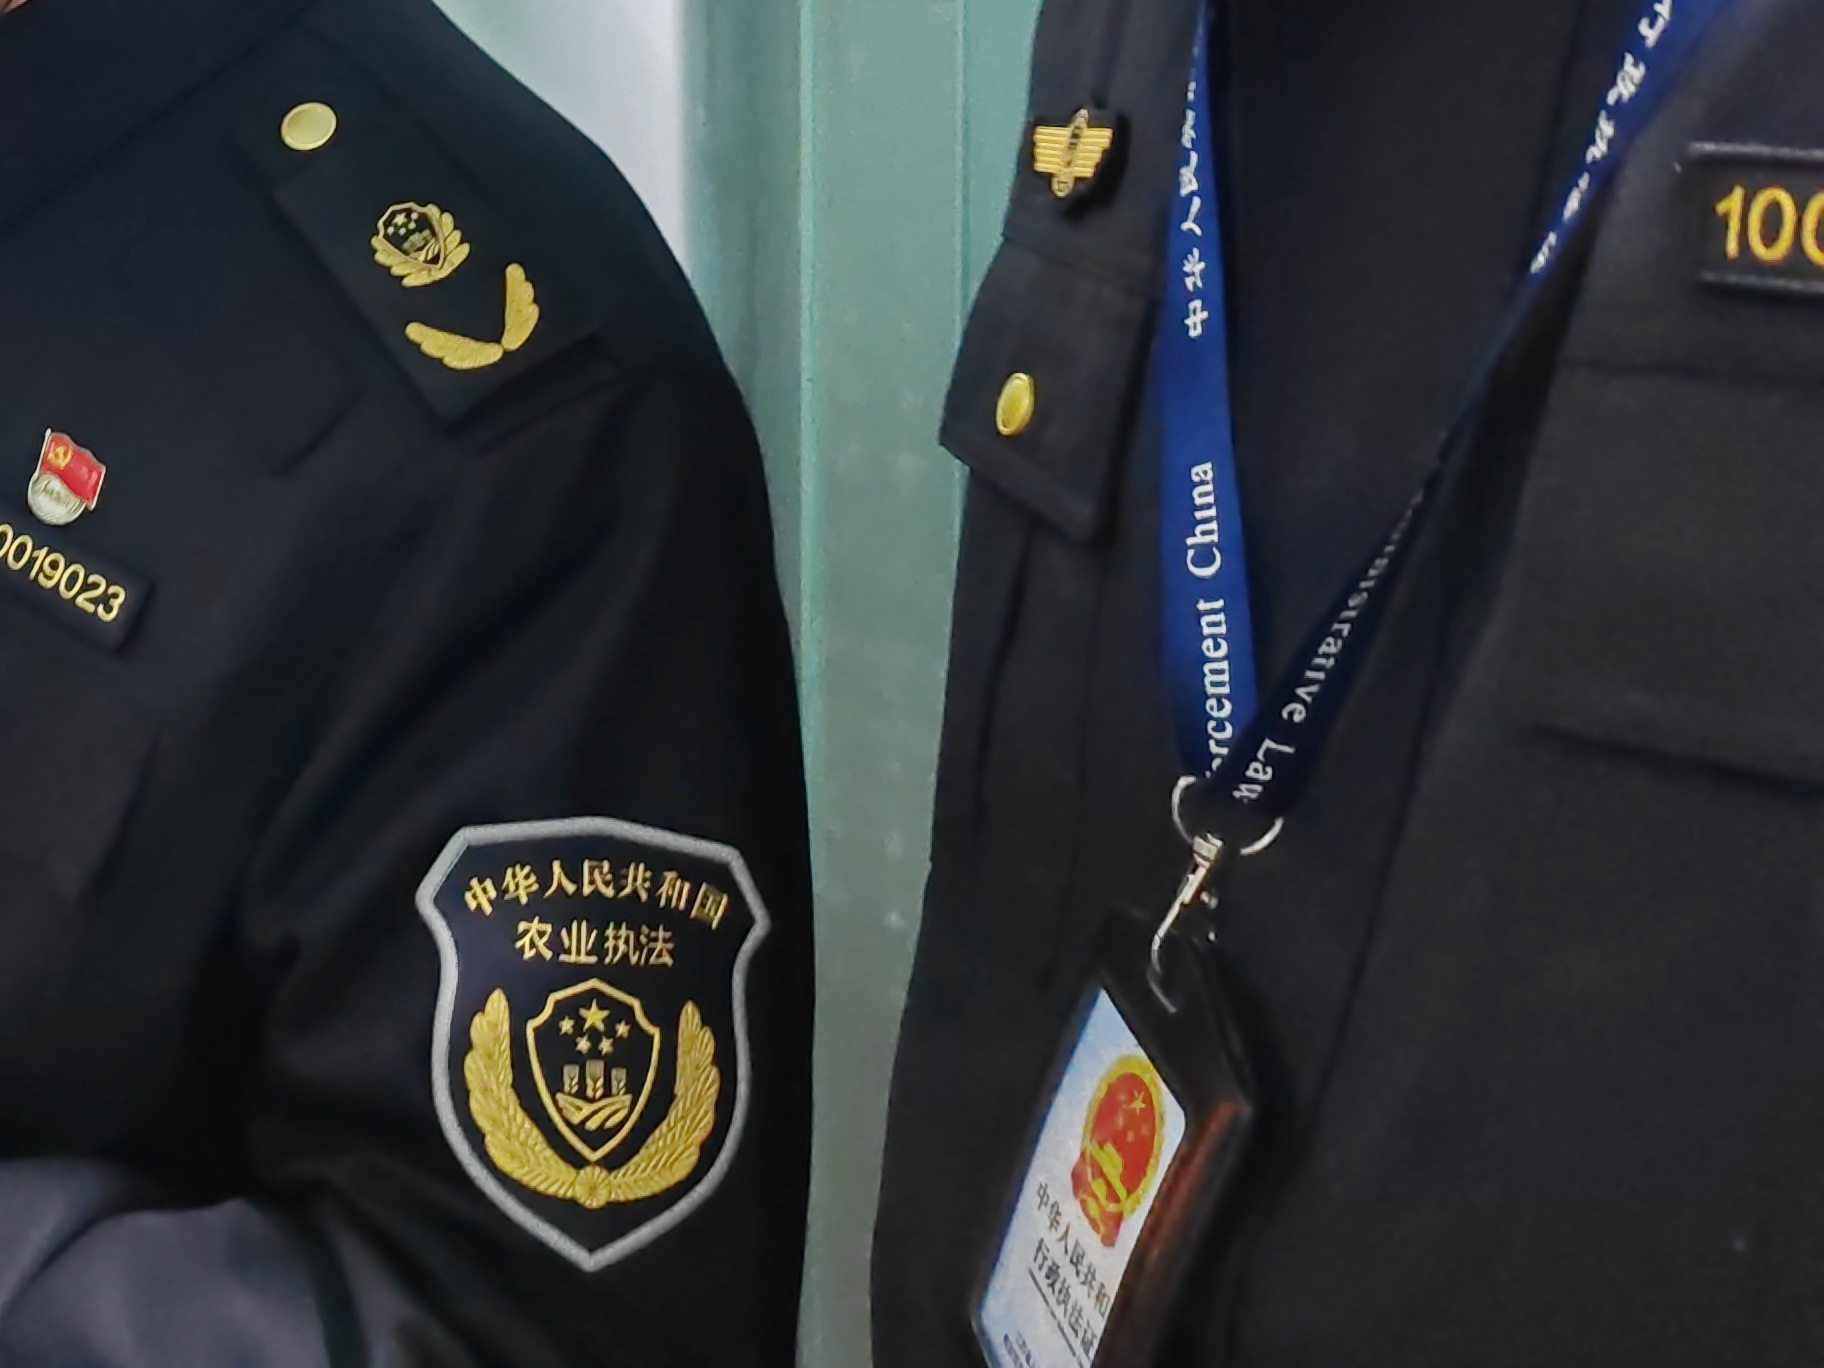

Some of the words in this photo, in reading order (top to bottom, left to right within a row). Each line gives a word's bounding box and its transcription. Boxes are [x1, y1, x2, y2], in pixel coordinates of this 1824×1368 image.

[1185, 460, 1223, 579] China
[463, 858, 729, 930] 中华人民共和国
[514, 915, 675, 967] 农业执法
